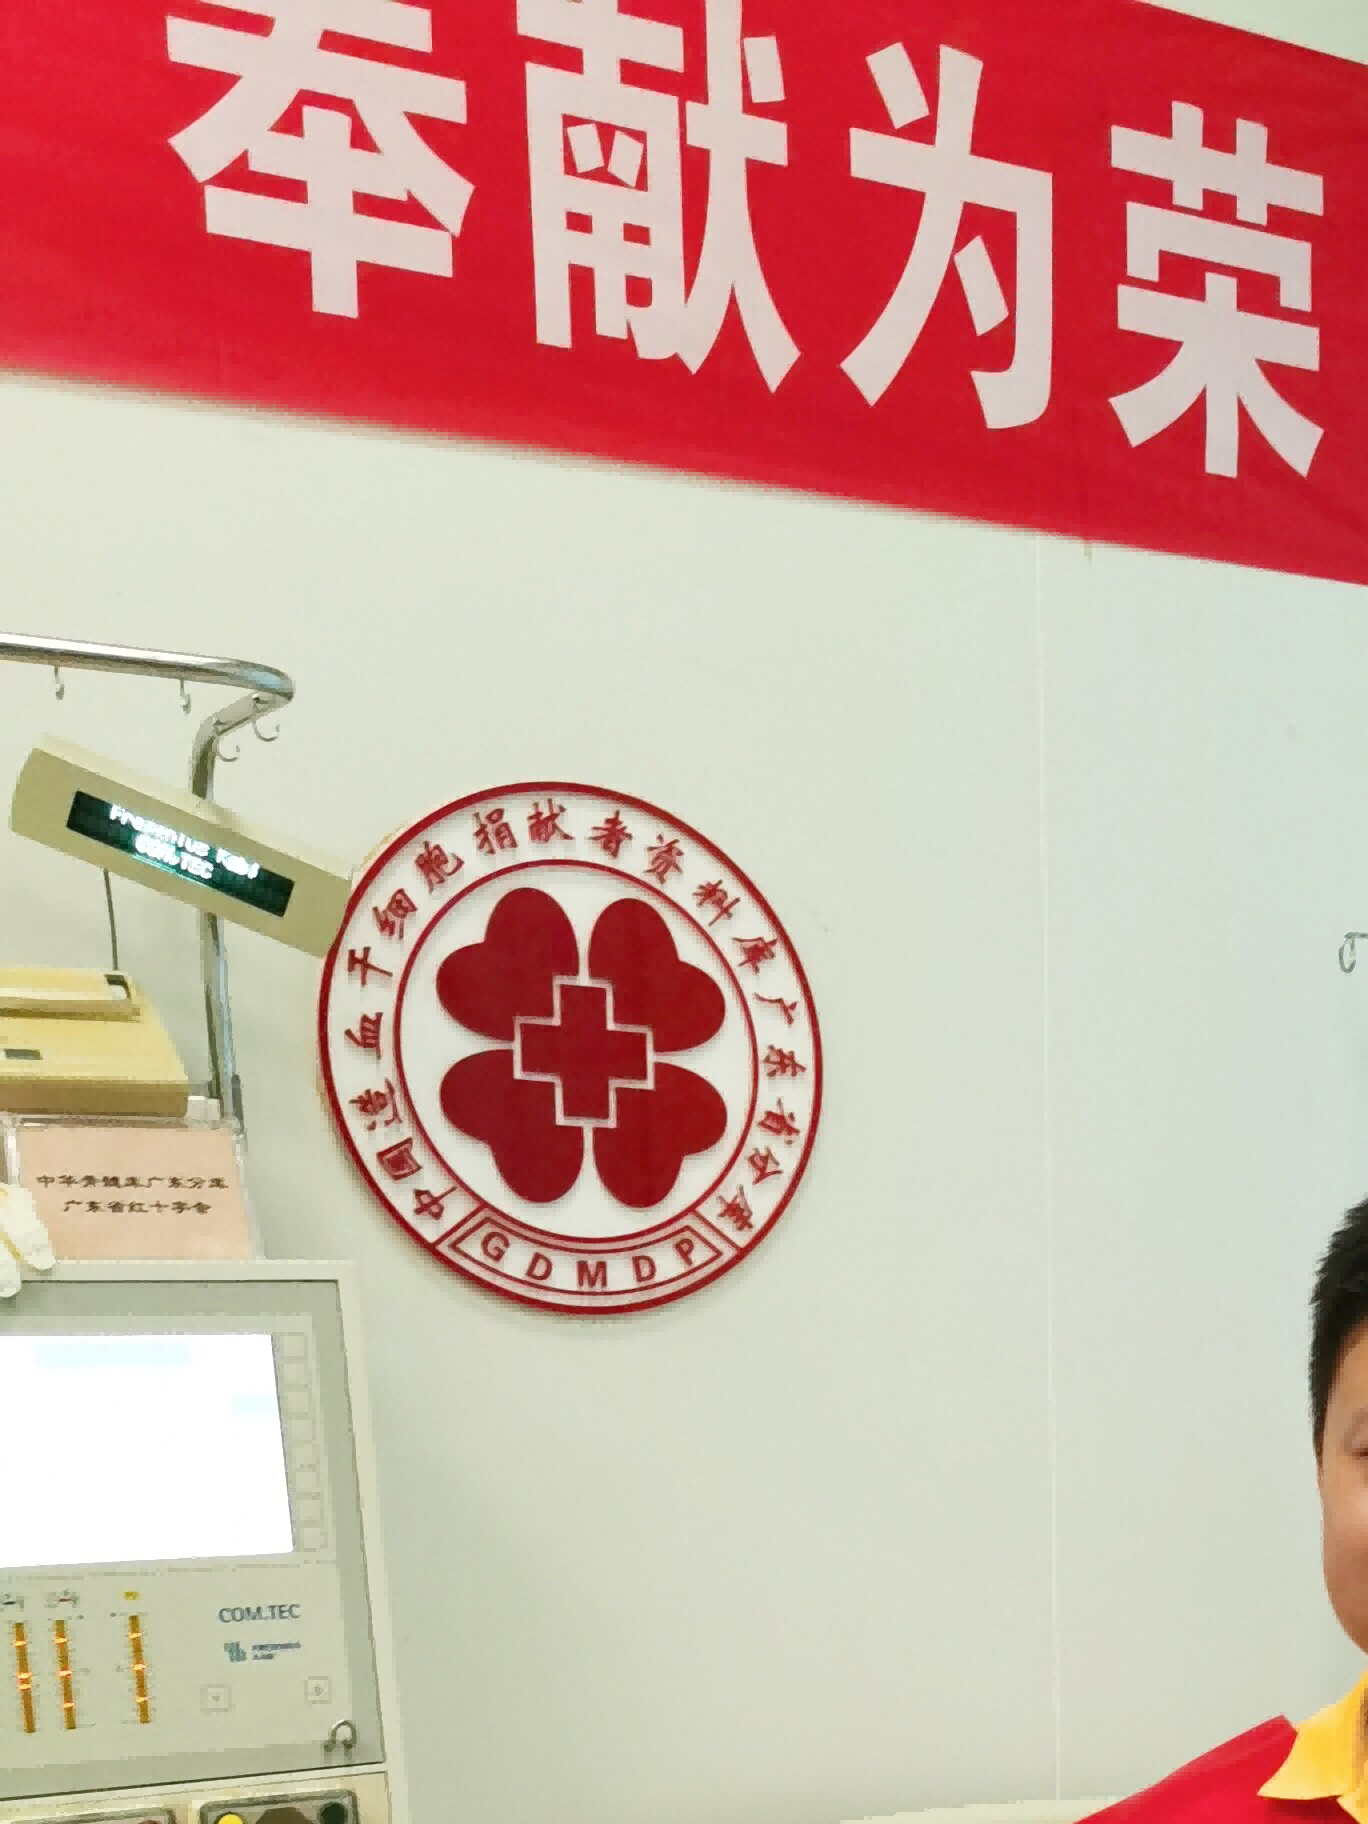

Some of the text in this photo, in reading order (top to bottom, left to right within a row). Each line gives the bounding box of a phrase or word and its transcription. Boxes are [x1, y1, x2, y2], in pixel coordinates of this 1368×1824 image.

[166, 0, 1327, 479] 奉献为荣
[480, 1231, 696, 1289] GDMDP
